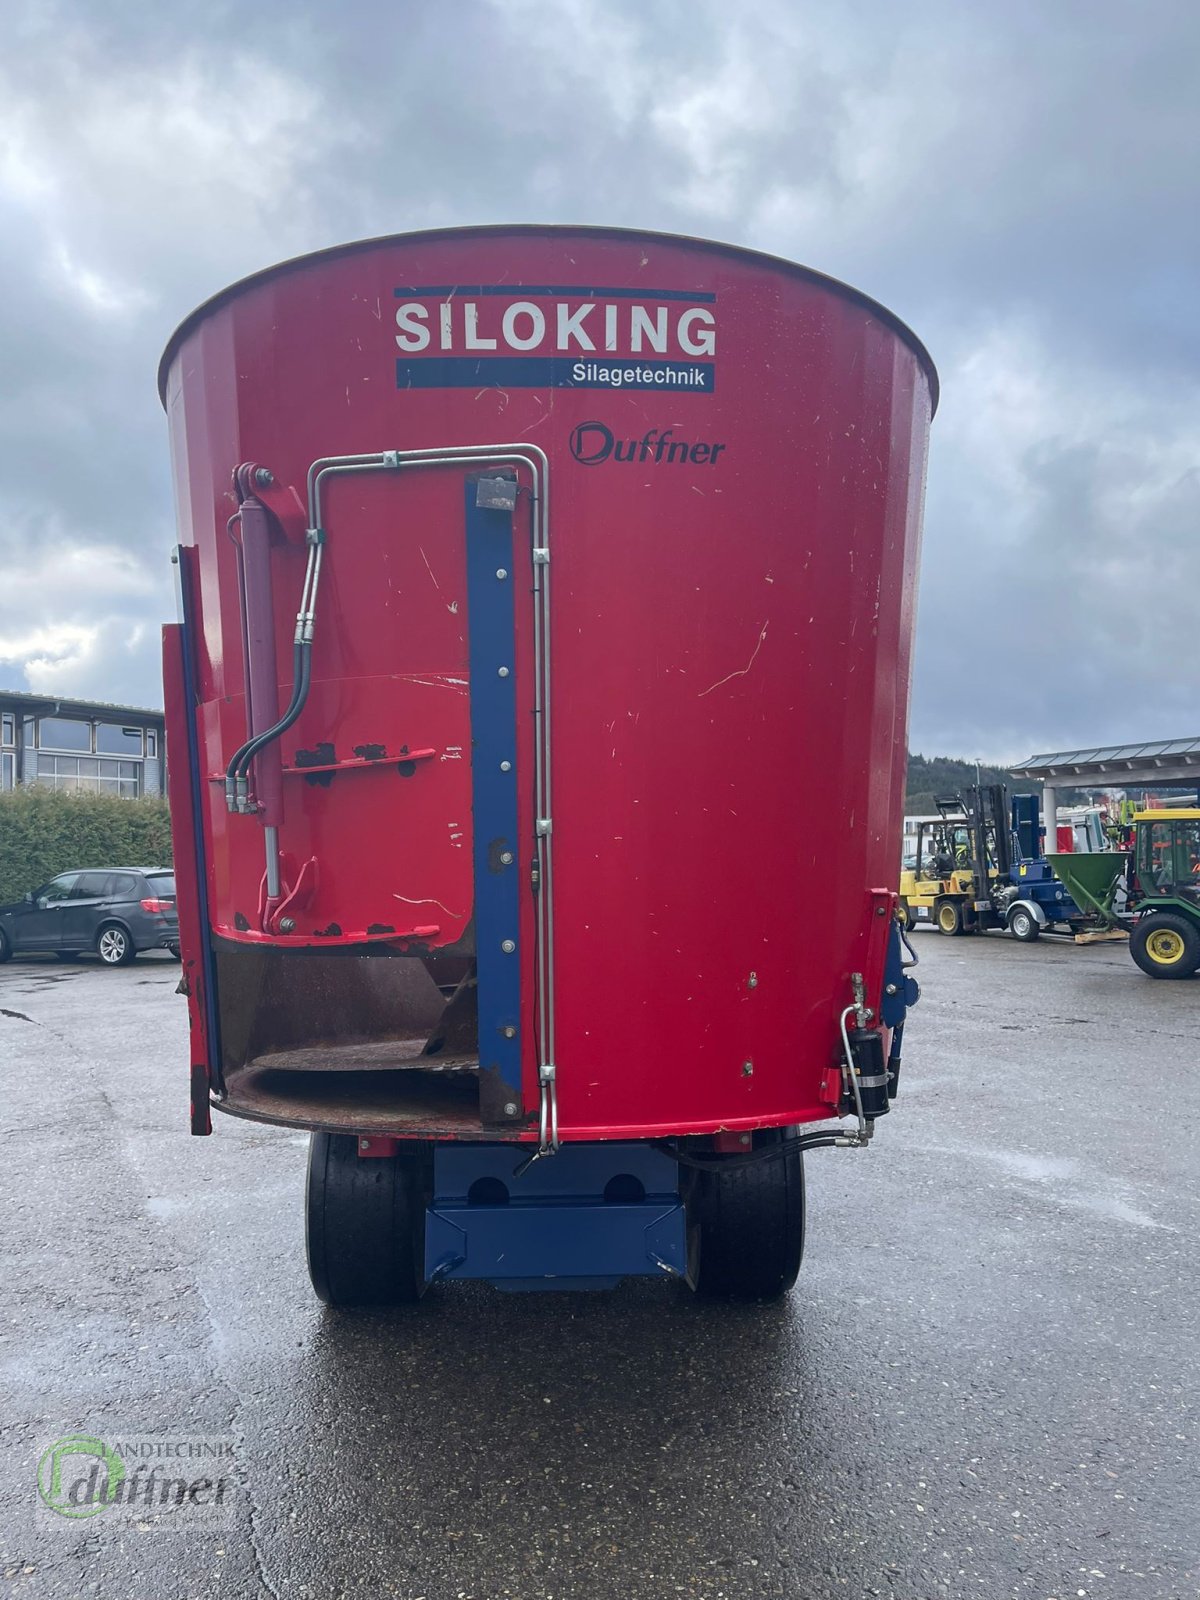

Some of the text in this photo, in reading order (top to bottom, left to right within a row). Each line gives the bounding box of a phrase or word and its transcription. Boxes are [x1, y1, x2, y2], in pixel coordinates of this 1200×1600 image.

[395, 301, 716, 356] SILOKING
[572, 363, 705, 387] Silagetechnik
[569, 421, 726, 465] Duffner
